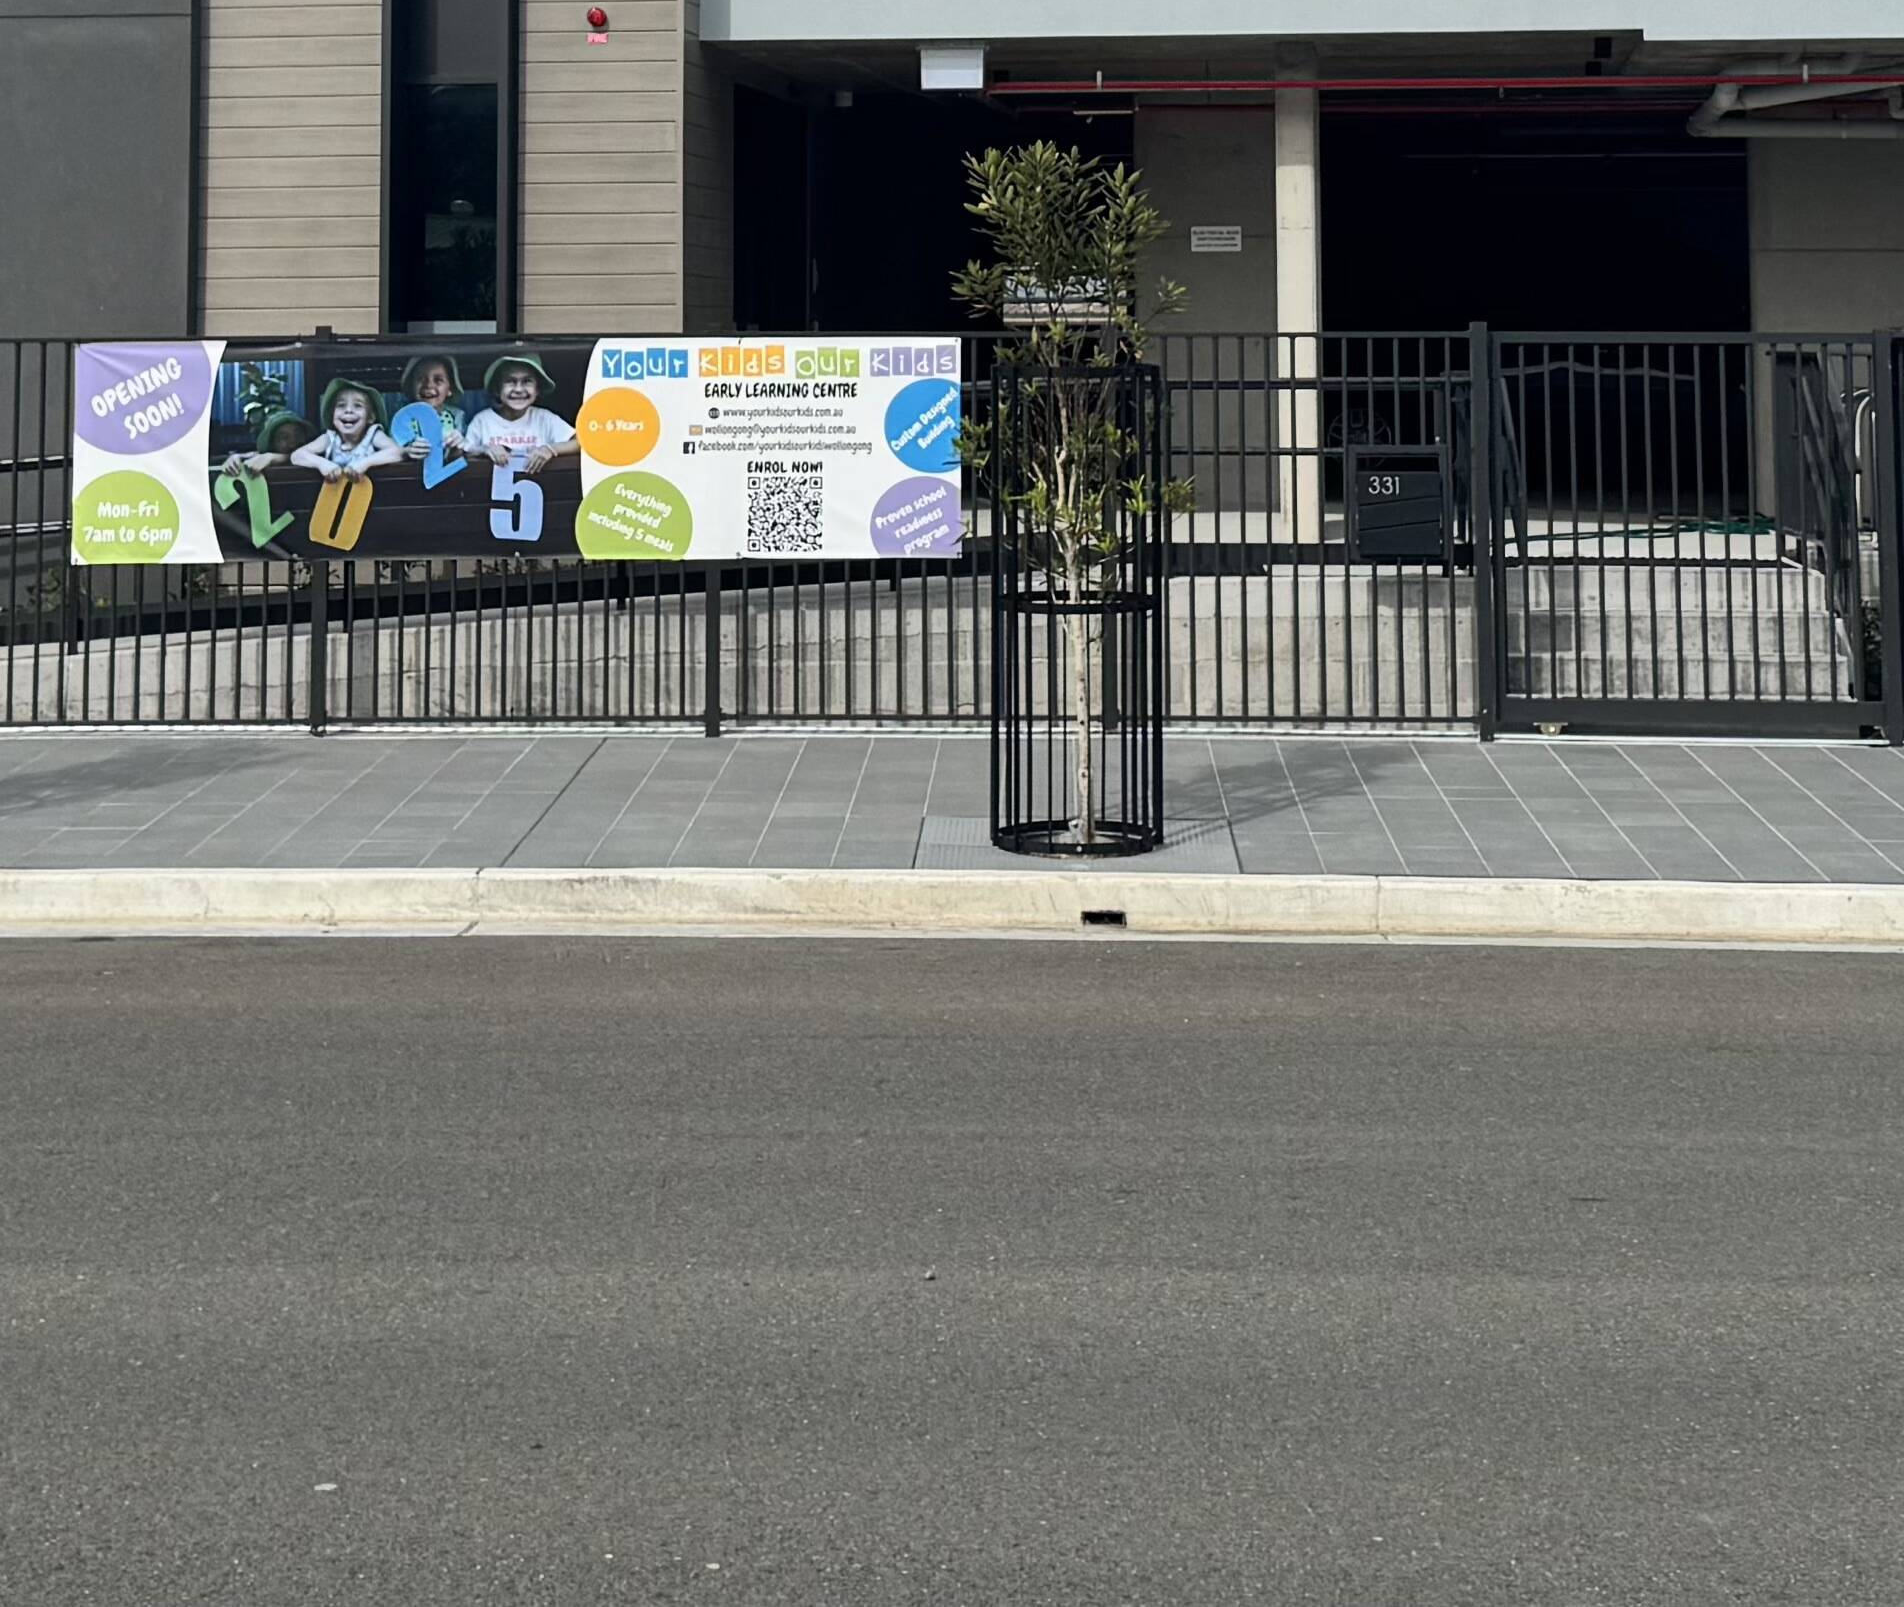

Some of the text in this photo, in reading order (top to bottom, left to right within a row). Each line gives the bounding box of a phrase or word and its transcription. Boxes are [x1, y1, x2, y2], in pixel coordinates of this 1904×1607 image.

[603, 350, 685, 376] Your
[700, 349, 783, 375] Kids
[872, 348, 954, 374] Kids
[91, 357, 182, 417] OPENING
[704, 382, 858, 399] EARLY LEARNING CENTRE
[123, 393, 185, 440] SOON!
[615, 420, 644, 431] Years
[723, 407, 844, 420] www.yourkidsourkids.com.au
[891, 386, 958, 451] Custom Designed
[917, 415, 955, 449] Building
[747, 461, 823, 474] ENROL NOW!
[614, 483, 673, 518] Everything
[1368, 476, 1400, 495] 331
[97, 500, 160, 518] Mon-Fri
[612, 503, 662, 529] provided
[875, 485, 947, 530] Proven school
[82, 525, 173, 547] 7am to 6pm
[588, 510, 674, 553] including 5 meals
[894, 507, 943, 539] readiness
[903, 523, 951, 556] program
